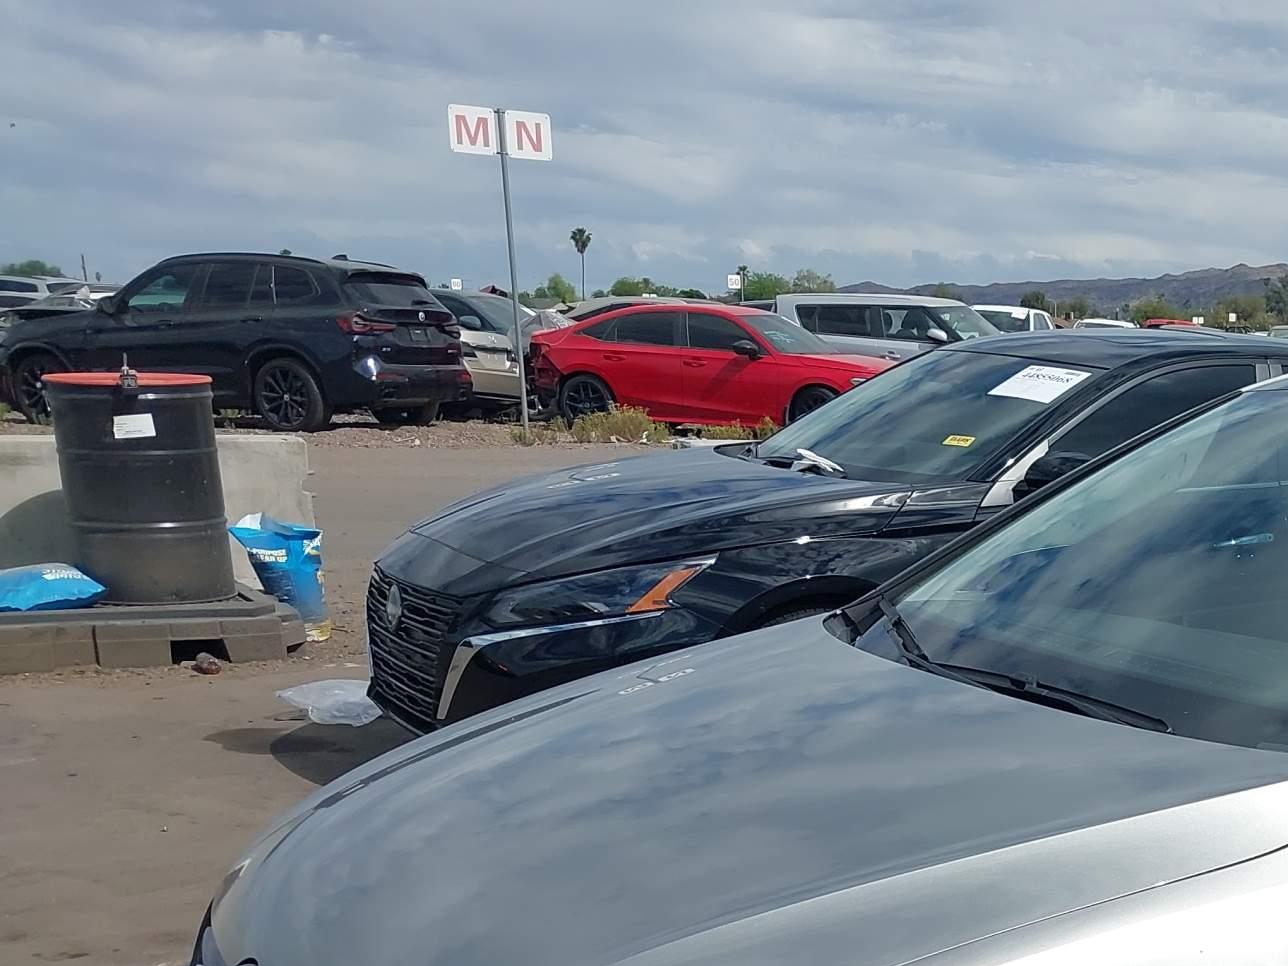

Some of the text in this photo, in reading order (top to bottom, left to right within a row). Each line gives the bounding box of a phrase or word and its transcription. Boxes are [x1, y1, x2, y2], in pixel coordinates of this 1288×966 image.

[454, 114, 490, 148] M
[515, 120, 543, 152] N
[729, 278, 740, 286] 50
